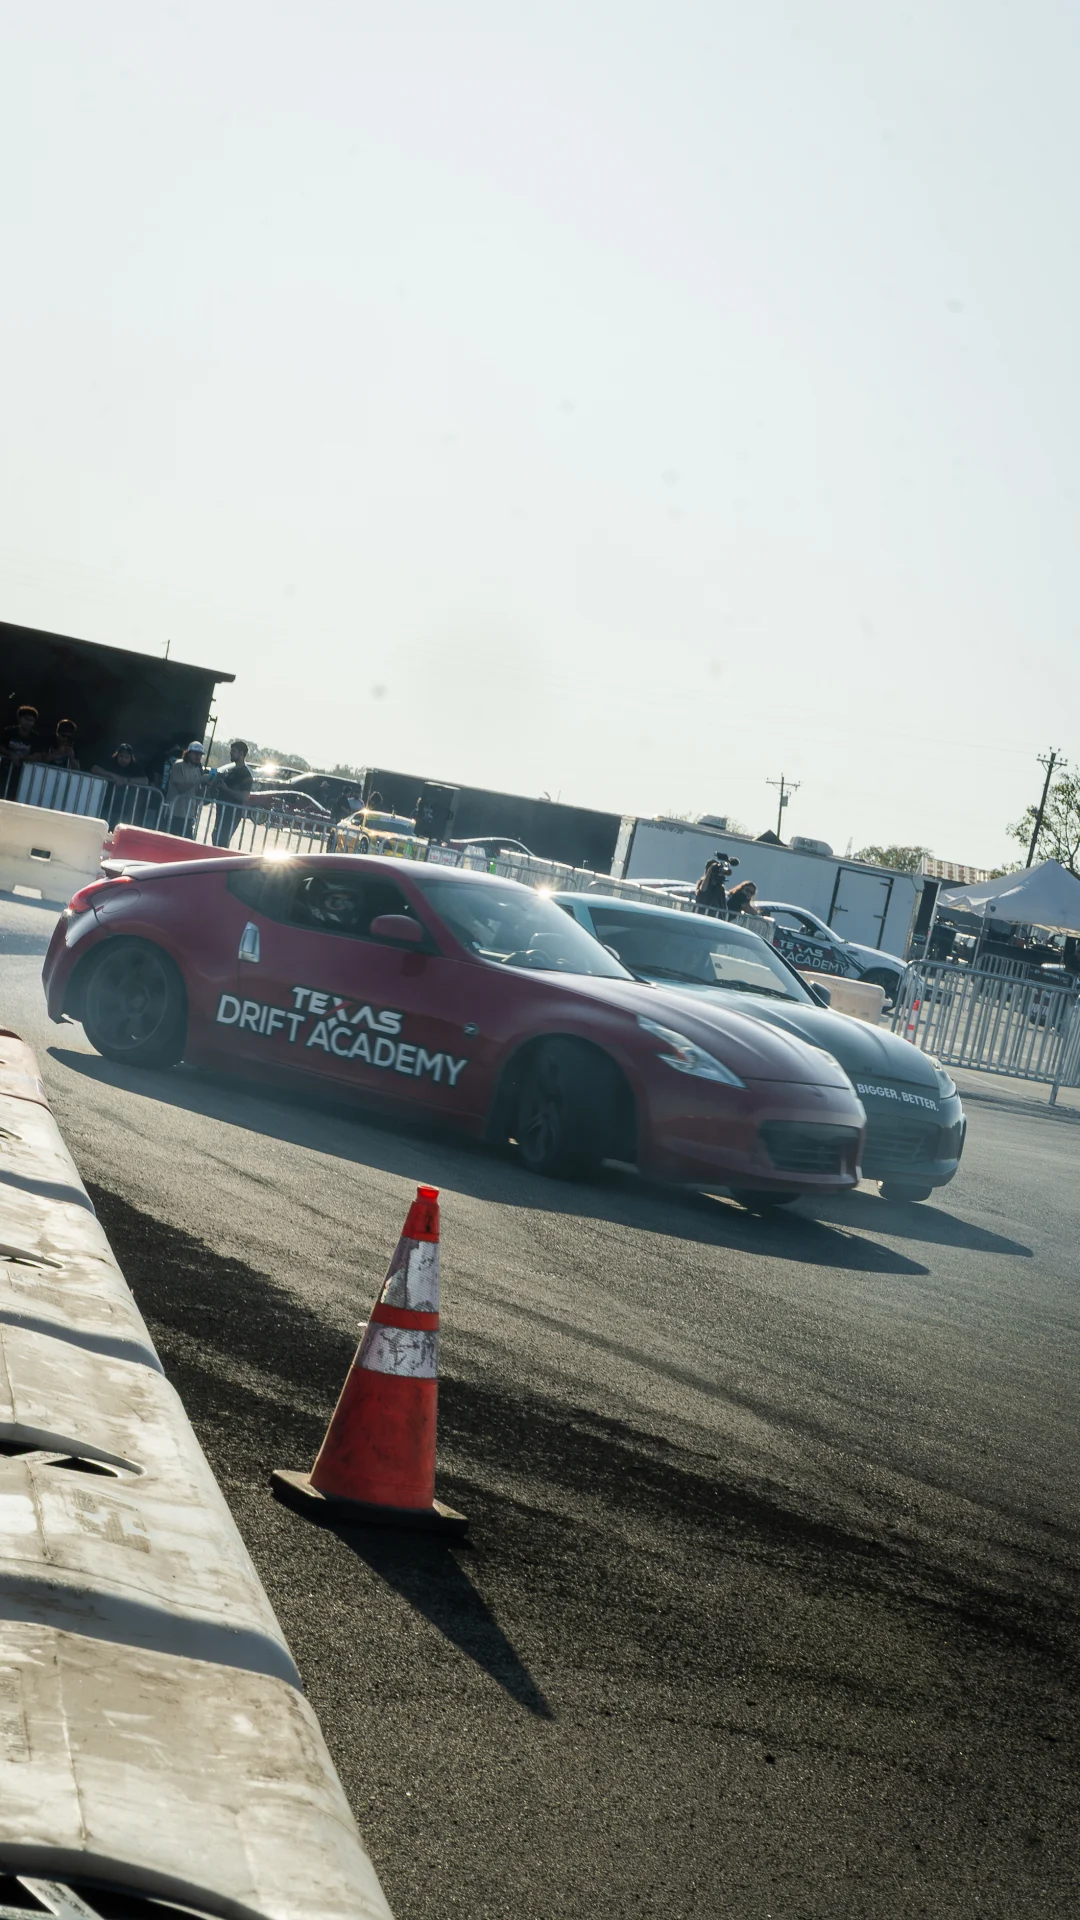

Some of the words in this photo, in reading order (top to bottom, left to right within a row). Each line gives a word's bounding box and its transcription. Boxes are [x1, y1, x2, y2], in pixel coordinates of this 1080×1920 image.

[780, 940, 824, 958] TEXAS
[785, 952, 849, 974] ACADEMY
[292, 986, 402, 1035] TEXAS
[216, 994, 305, 1042] DRIFT
[306, 1021, 468, 1085] ACADEMY
[901, 1092, 939, 1111] BETTER.
